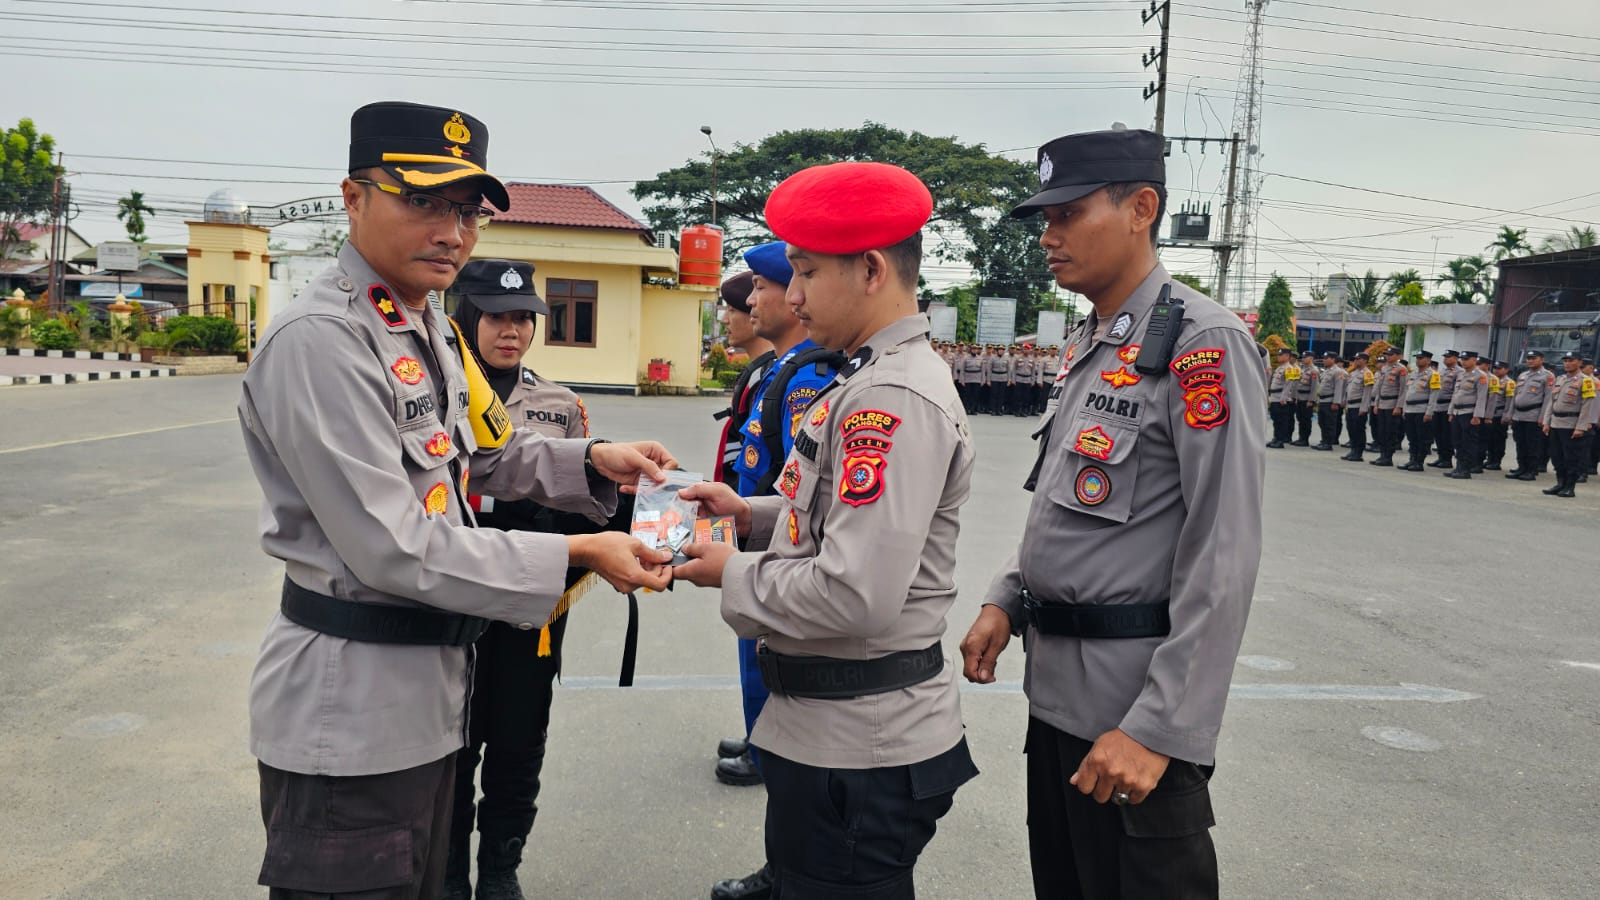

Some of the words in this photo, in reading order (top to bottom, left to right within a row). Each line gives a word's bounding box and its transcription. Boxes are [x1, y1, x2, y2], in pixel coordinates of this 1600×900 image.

[1174, 351, 1220, 370] POLRES
[1188, 373, 1215, 384] ACEH
[1085, 392, 1139, 418] POLRI
[526, 410, 567, 426] POLRI
[844, 412, 892, 430] POLRES
[851, 420, 883, 430] LANGSA
[850, 439, 883, 448] ACEH
